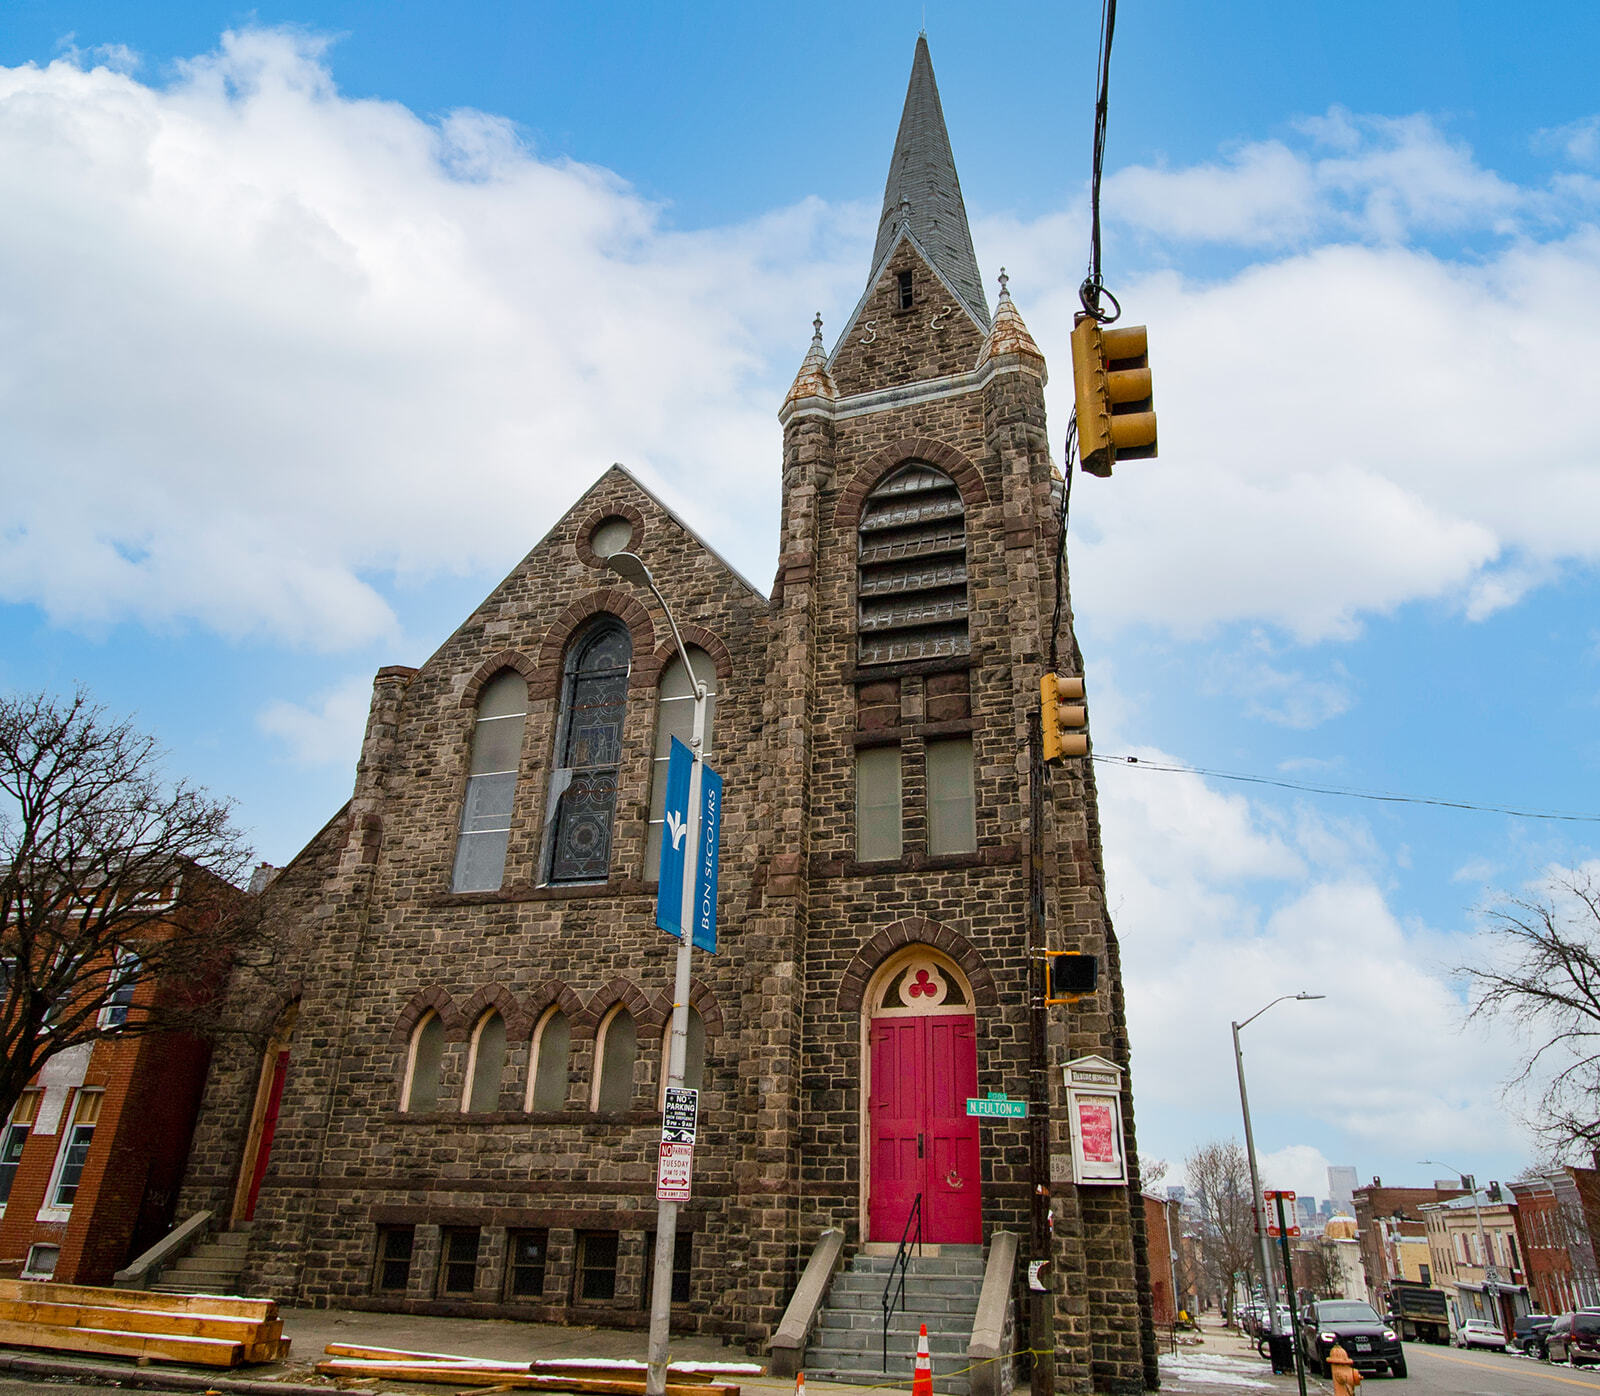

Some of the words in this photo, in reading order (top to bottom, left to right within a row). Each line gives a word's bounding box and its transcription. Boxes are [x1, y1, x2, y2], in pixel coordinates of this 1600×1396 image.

[704, 788, 716, 879] SECOURS
[701, 883, 712, 930] BON
[676, 1095, 687, 1103] NO
[666, 1102, 695, 1112] PARKING
[979, 1102, 1012, 1114] FULTON
[661, 1145, 672, 1156] NO
[672, 1147, 691, 1156] PARKING
[662, 1159, 689, 1168] TUESDAY
[1486, 1272, 1497, 1280] 25
